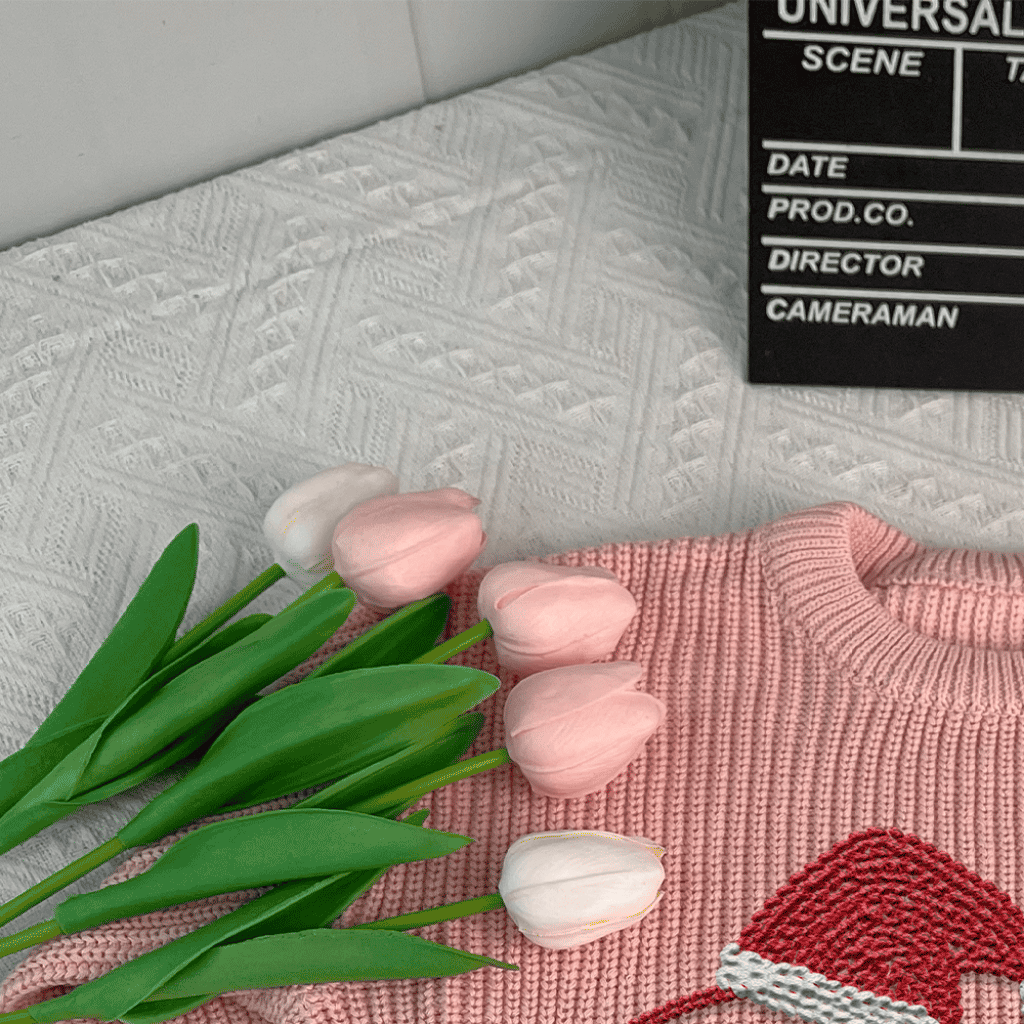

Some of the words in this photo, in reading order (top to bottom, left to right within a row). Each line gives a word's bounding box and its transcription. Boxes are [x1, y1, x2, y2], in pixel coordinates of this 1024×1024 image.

[801, 44, 925, 77] SCENE
[766, 153, 849, 179] DATE
[766, 197, 914, 227] PROD.CO.
[767, 249, 925, 278] DIRECTOR
[766, 298, 960, 329] CAMERAMAN
